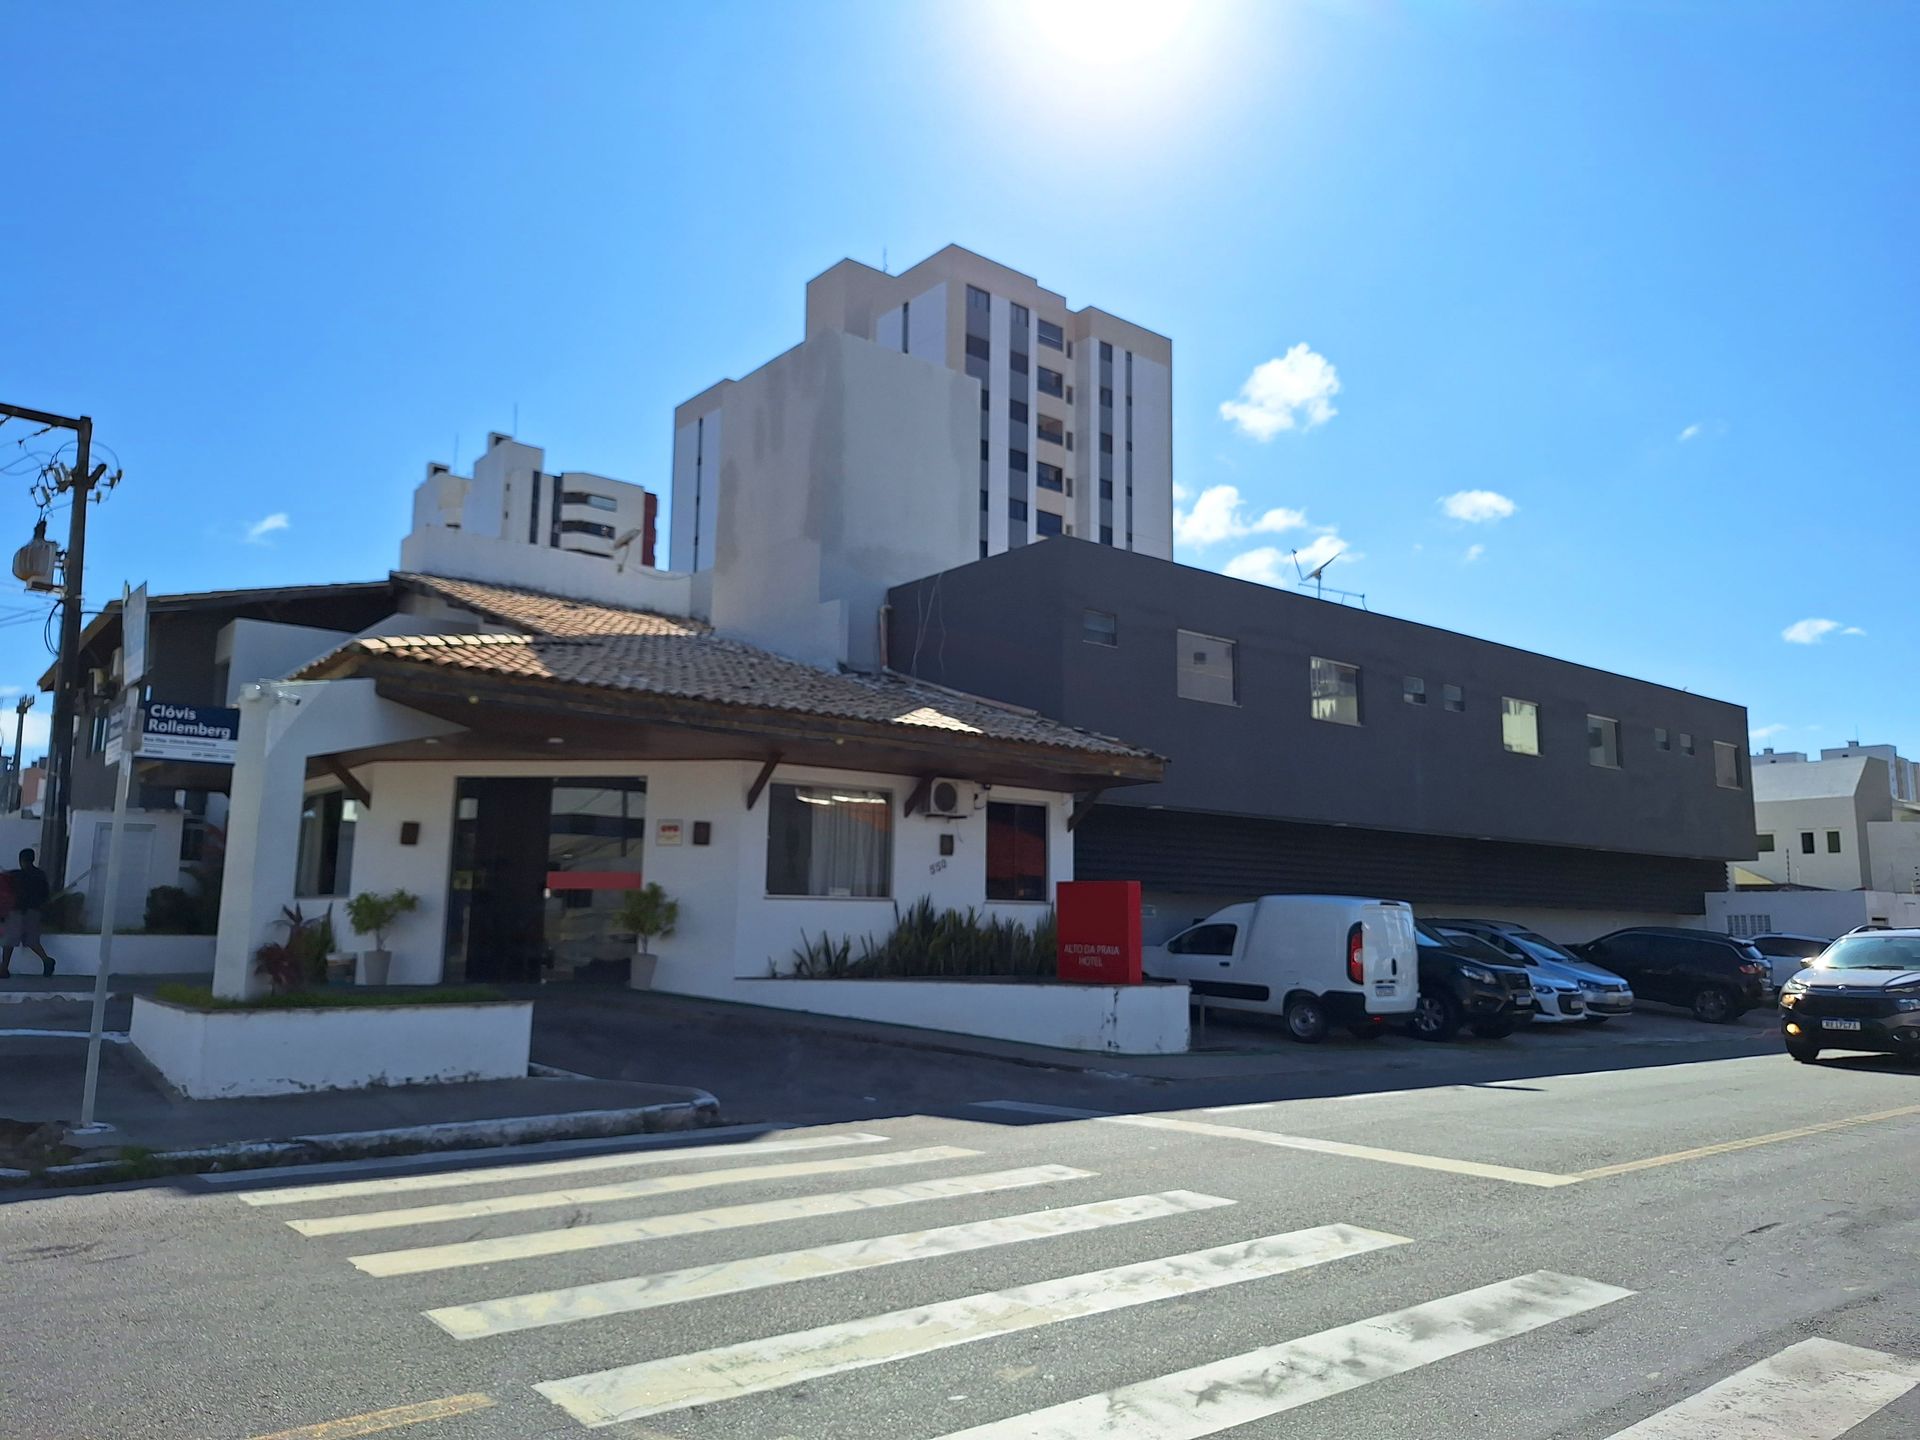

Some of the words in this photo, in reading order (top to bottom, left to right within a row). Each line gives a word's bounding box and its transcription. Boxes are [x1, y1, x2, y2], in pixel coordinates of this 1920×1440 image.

[151, 704, 197, 721] Clóvis
[148, 719, 231, 740] Rollemberg
[1064, 943, 1083, 954] ALTO
[1084, 944, 1096, 954] DA
[1097, 945, 1120, 955] PRAIA
[1078, 956, 1103, 968] HOTEL
